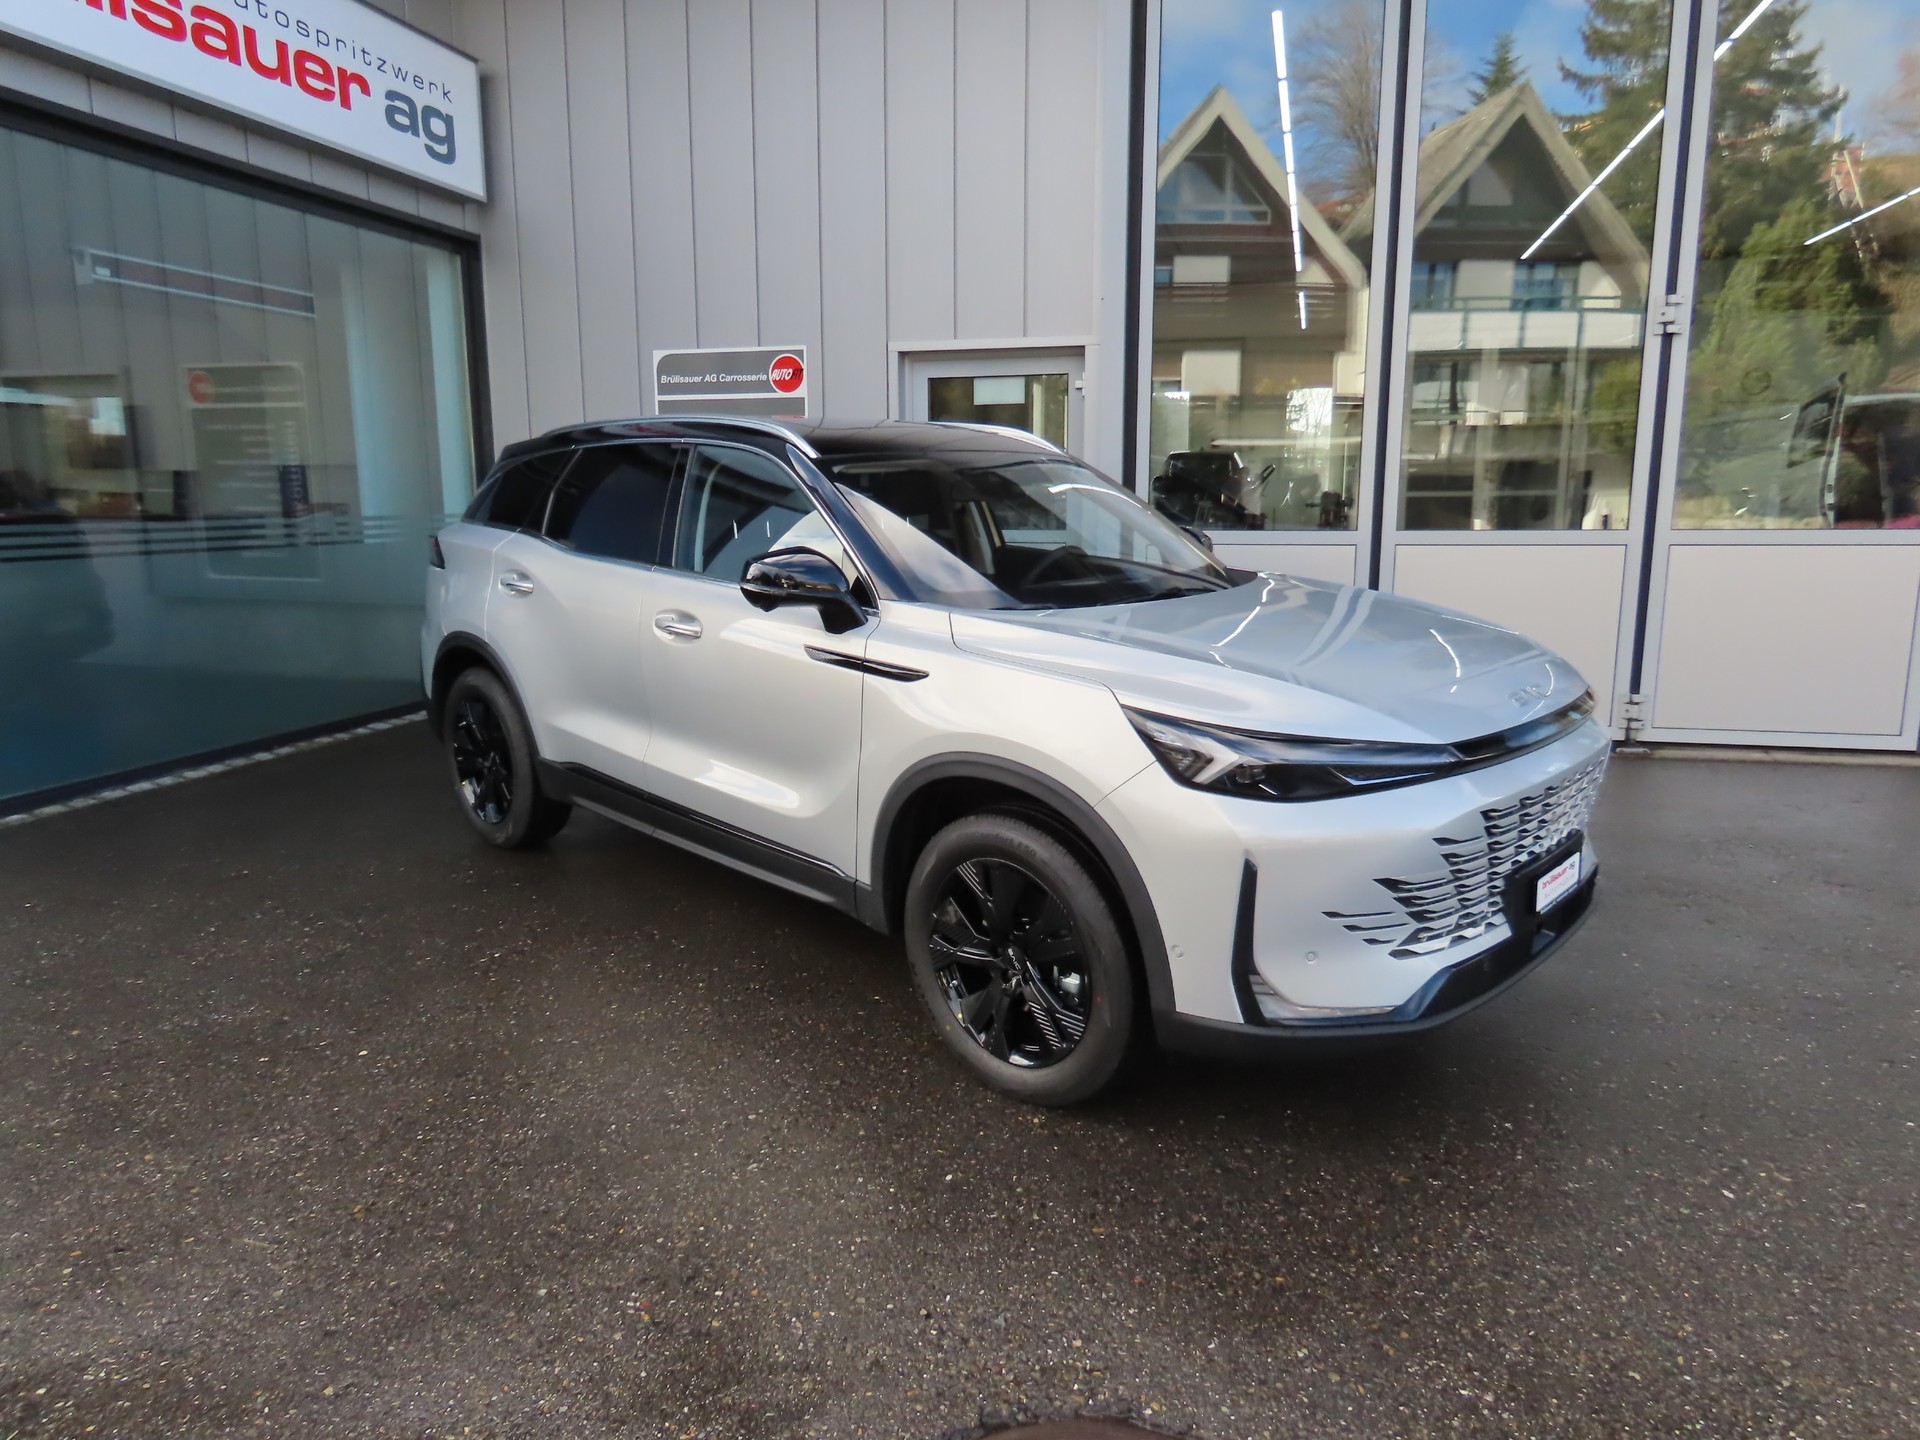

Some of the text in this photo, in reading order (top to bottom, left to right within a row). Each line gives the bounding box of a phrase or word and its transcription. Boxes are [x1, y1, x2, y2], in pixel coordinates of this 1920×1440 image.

[234, 0, 453, 103] utospritzwerk
[384, 89, 457, 165] ag
[660, 372, 768, 384] Brülisauer AG Carrosserie
